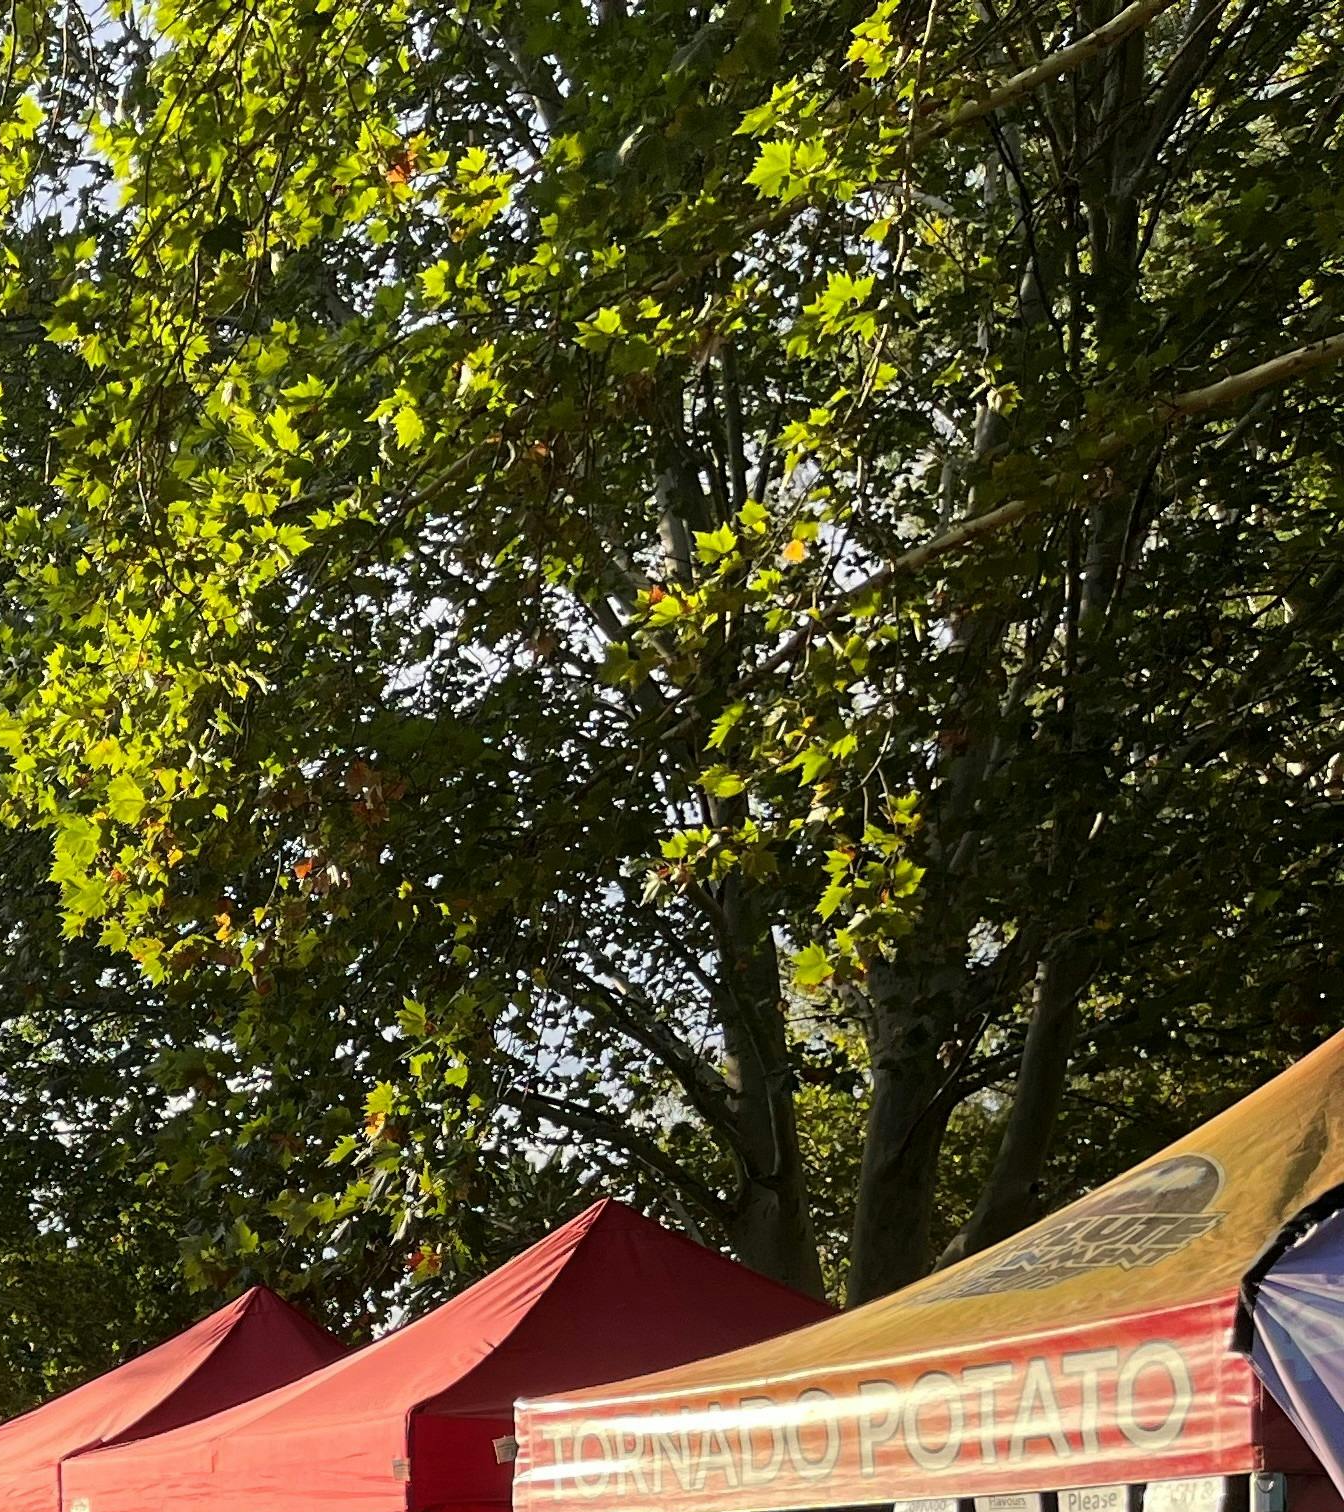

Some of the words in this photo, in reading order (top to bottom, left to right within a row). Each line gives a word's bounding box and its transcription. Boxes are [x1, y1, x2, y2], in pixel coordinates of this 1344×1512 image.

[540, 1388, 845, 1502] TORNADO
[858, 1342, 1194, 1476] POTATO
[1068, 1492, 1118, 1512] Please
